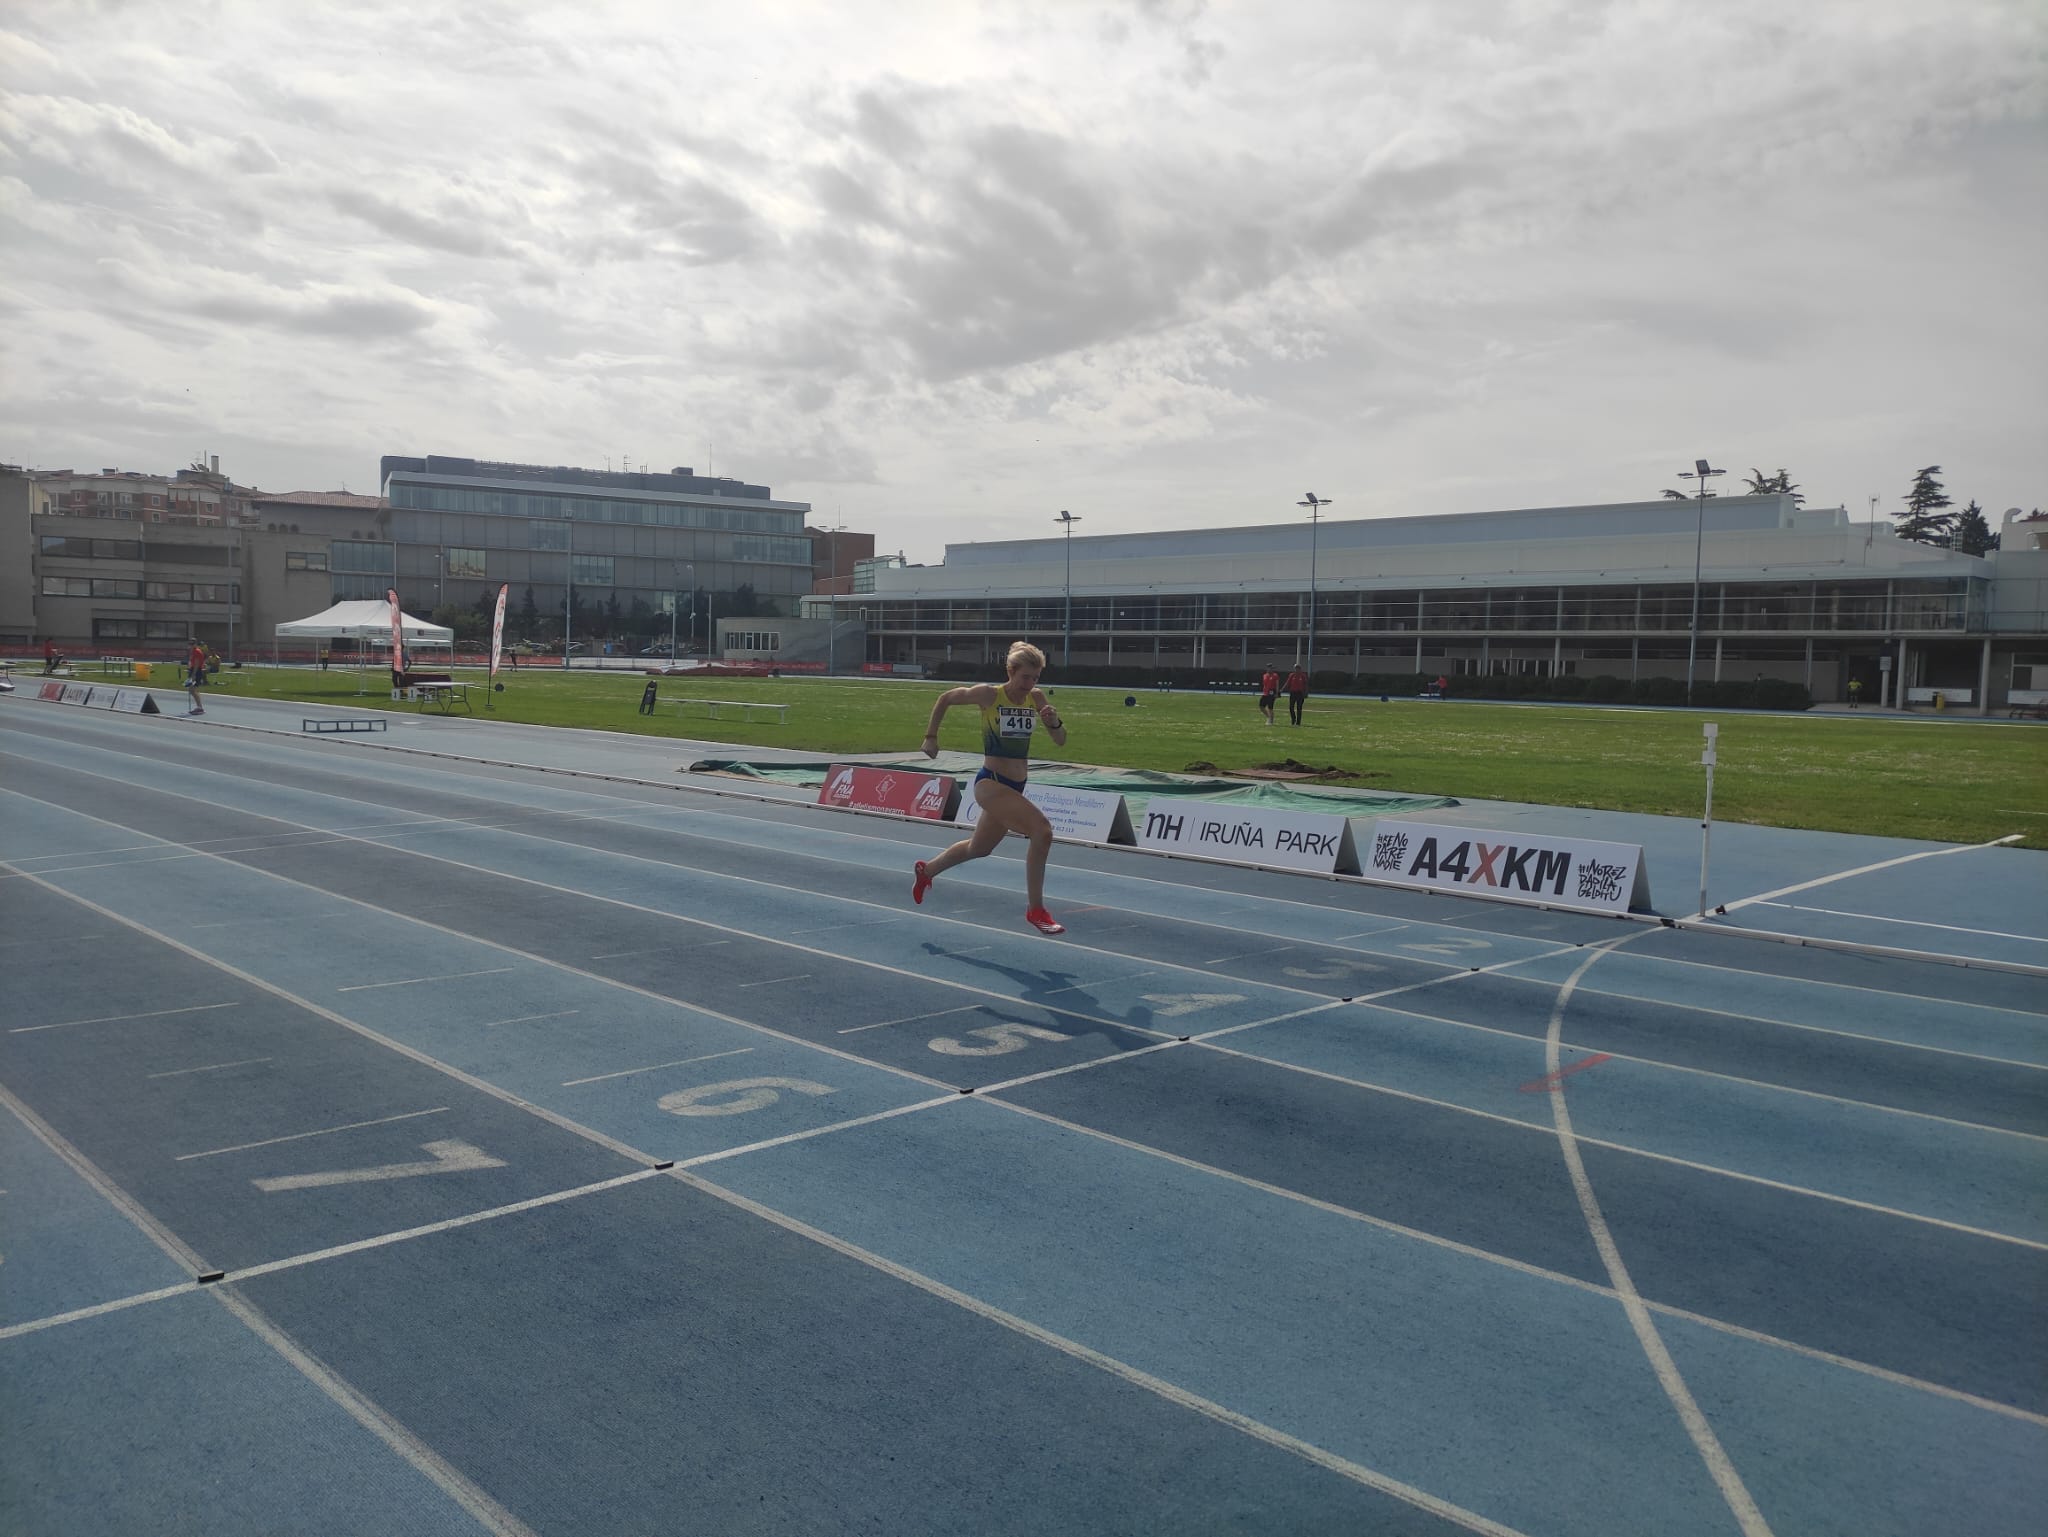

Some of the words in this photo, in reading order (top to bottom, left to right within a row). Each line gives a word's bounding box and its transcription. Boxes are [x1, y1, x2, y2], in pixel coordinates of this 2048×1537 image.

[1007, 717, 1032, 729] 418
[835, 784, 855, 795] FNA
[921, 795, 944, 808] FNA
[1199, 821, 1264, 849] IRUÑA
[1275, 829, 1338, 857] PARK
[1376, 843, 1407, 861] PARE
[1373, 855, 1402, 871] NADIE
[1408, 837, 1572, 895] A4XKM
[1578, 883, 1622, 901] GELDITU
[1400, 936, 1493, 955] 2
[1281, 958, 1391, 981] 3
[1140, 993, 1248, 1017] 4
[927, 1022, 1074, 1056] 5
[656, 1076, 840, 1117] 6
[250, 1137, 509, 1193] 7
